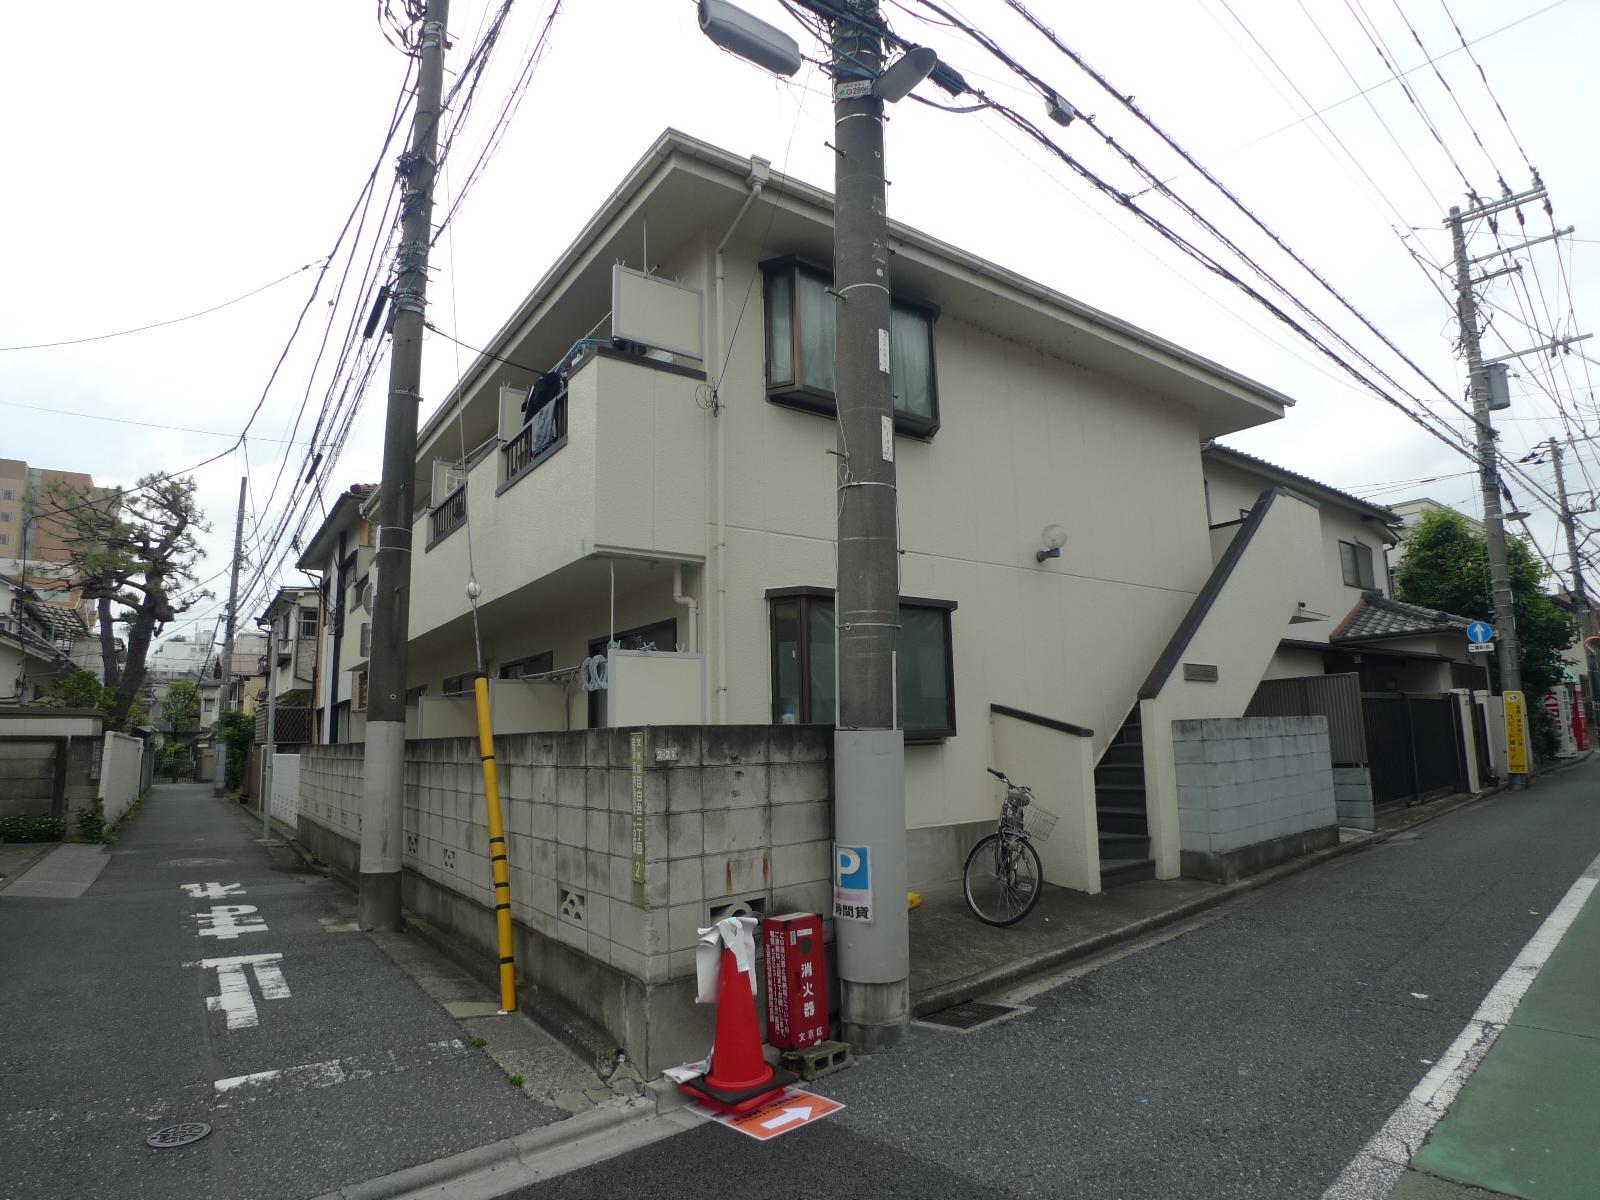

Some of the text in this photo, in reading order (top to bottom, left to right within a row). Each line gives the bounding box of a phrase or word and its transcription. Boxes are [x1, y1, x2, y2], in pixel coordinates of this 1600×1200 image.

[635, 861, 640, 878] 2
[836, 848, 860, 887] P
[801, 961, 816, 1018] 消火器
[799, 1026, 823, 1043] 文京区
